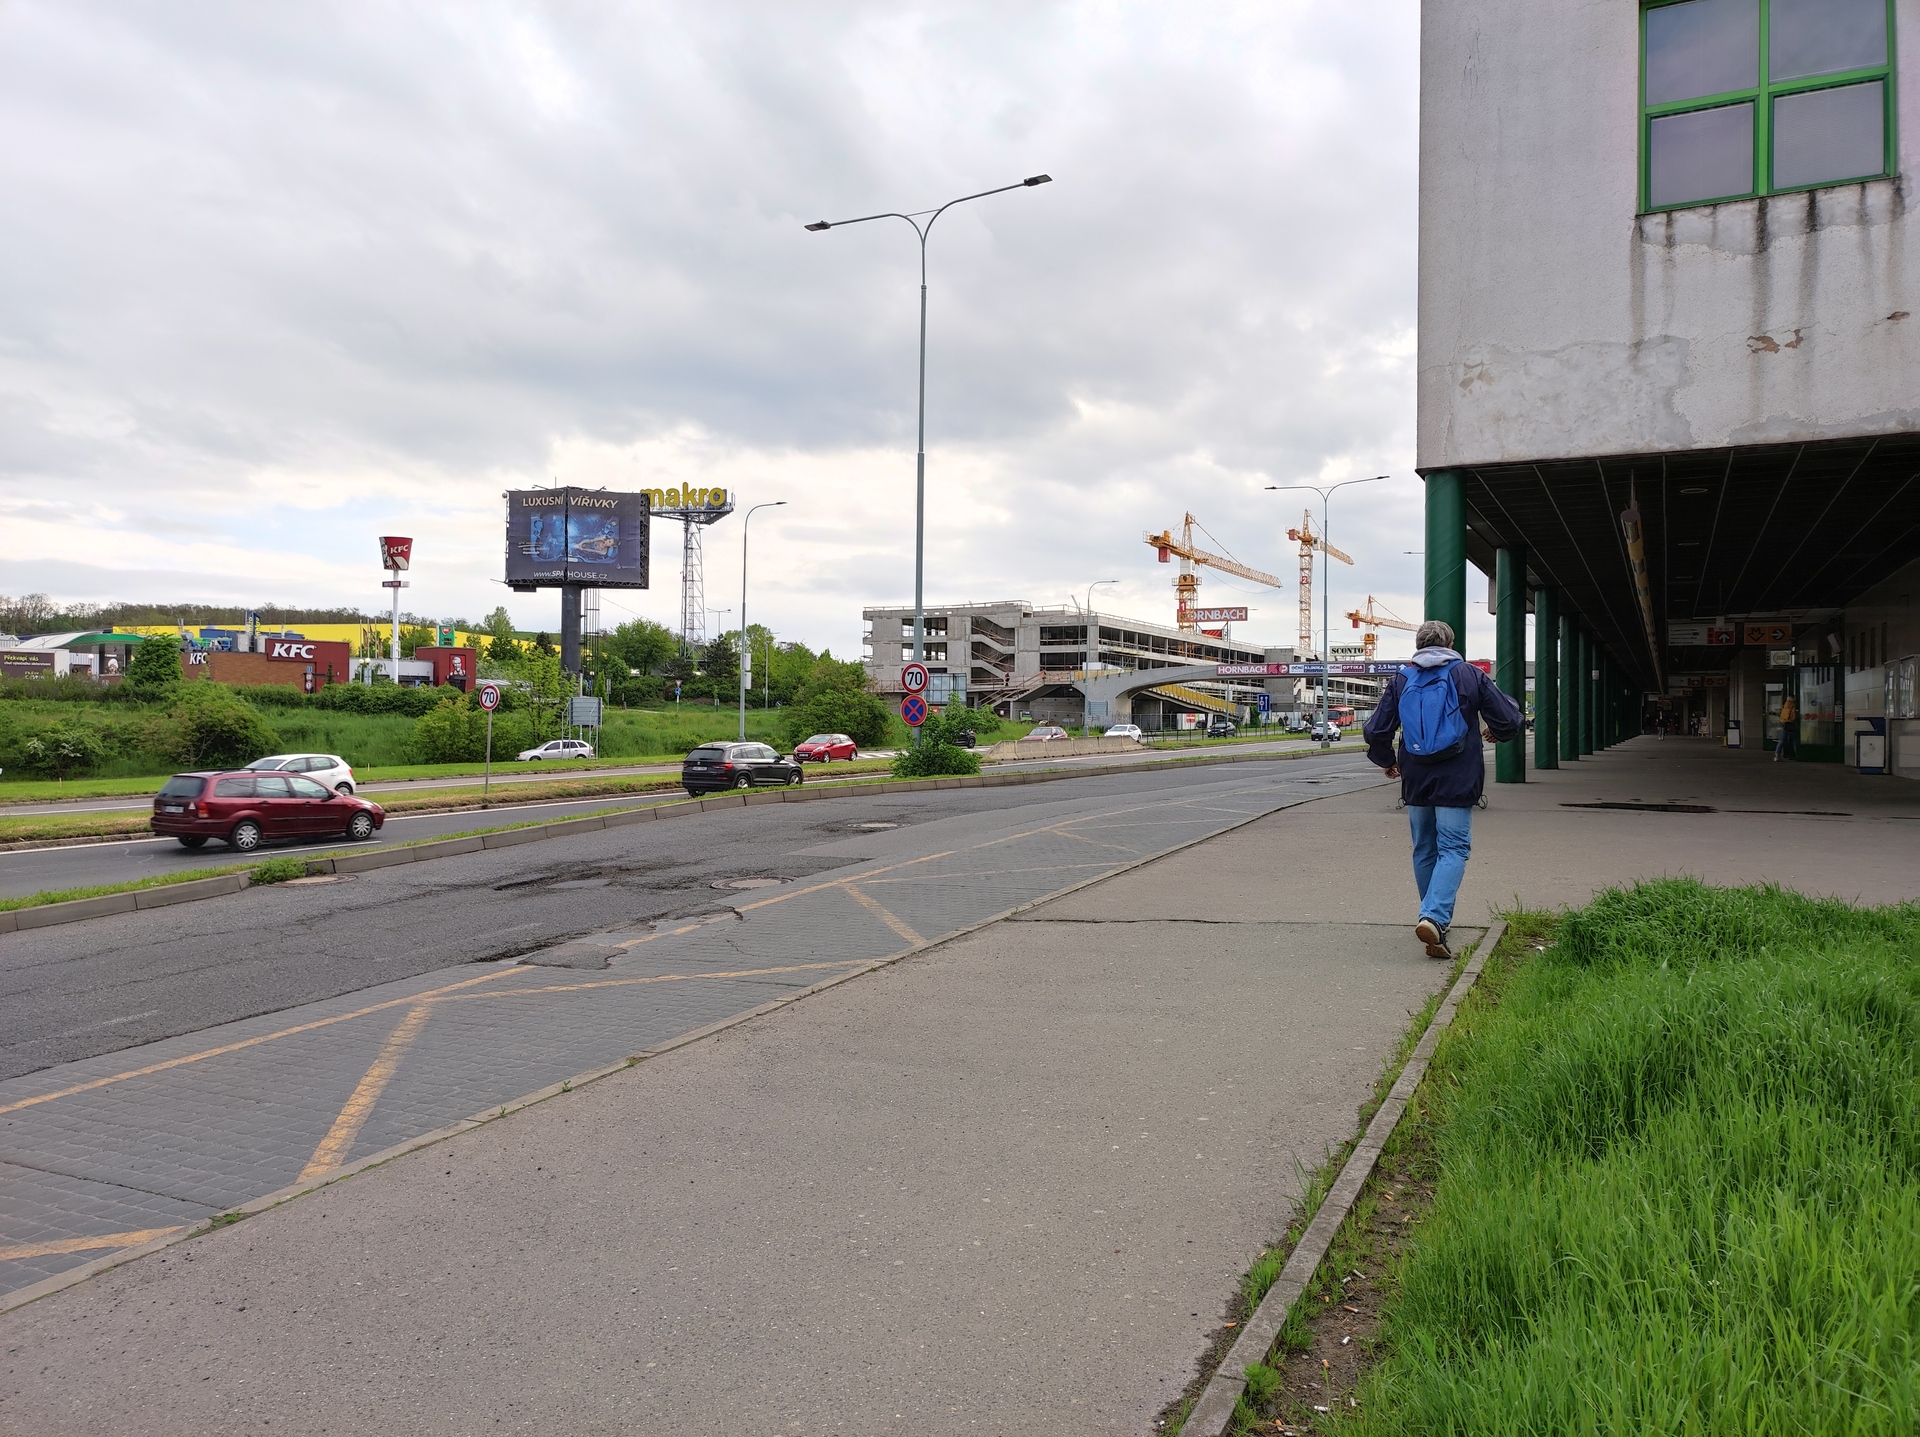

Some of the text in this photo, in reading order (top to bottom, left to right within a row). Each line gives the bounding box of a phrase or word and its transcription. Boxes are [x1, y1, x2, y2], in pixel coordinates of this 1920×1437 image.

[640, 482, 726, 507] makro
[522, 494, 619, 509] LUXUSNÍ VÍŘIVKY
[390, 545, 409, 555] KFC
[1180, 602, 1186, 611] 1
[272, 643, 315, 659] KFC
[1331, 647, 1364, 655] SCONTO
[189, 652, 208, 665] KFC
[1218, 664, 1267, 674] HORNBACH
[907, 671, 923, 686] 70
[483, 691, 495, 704] 70
